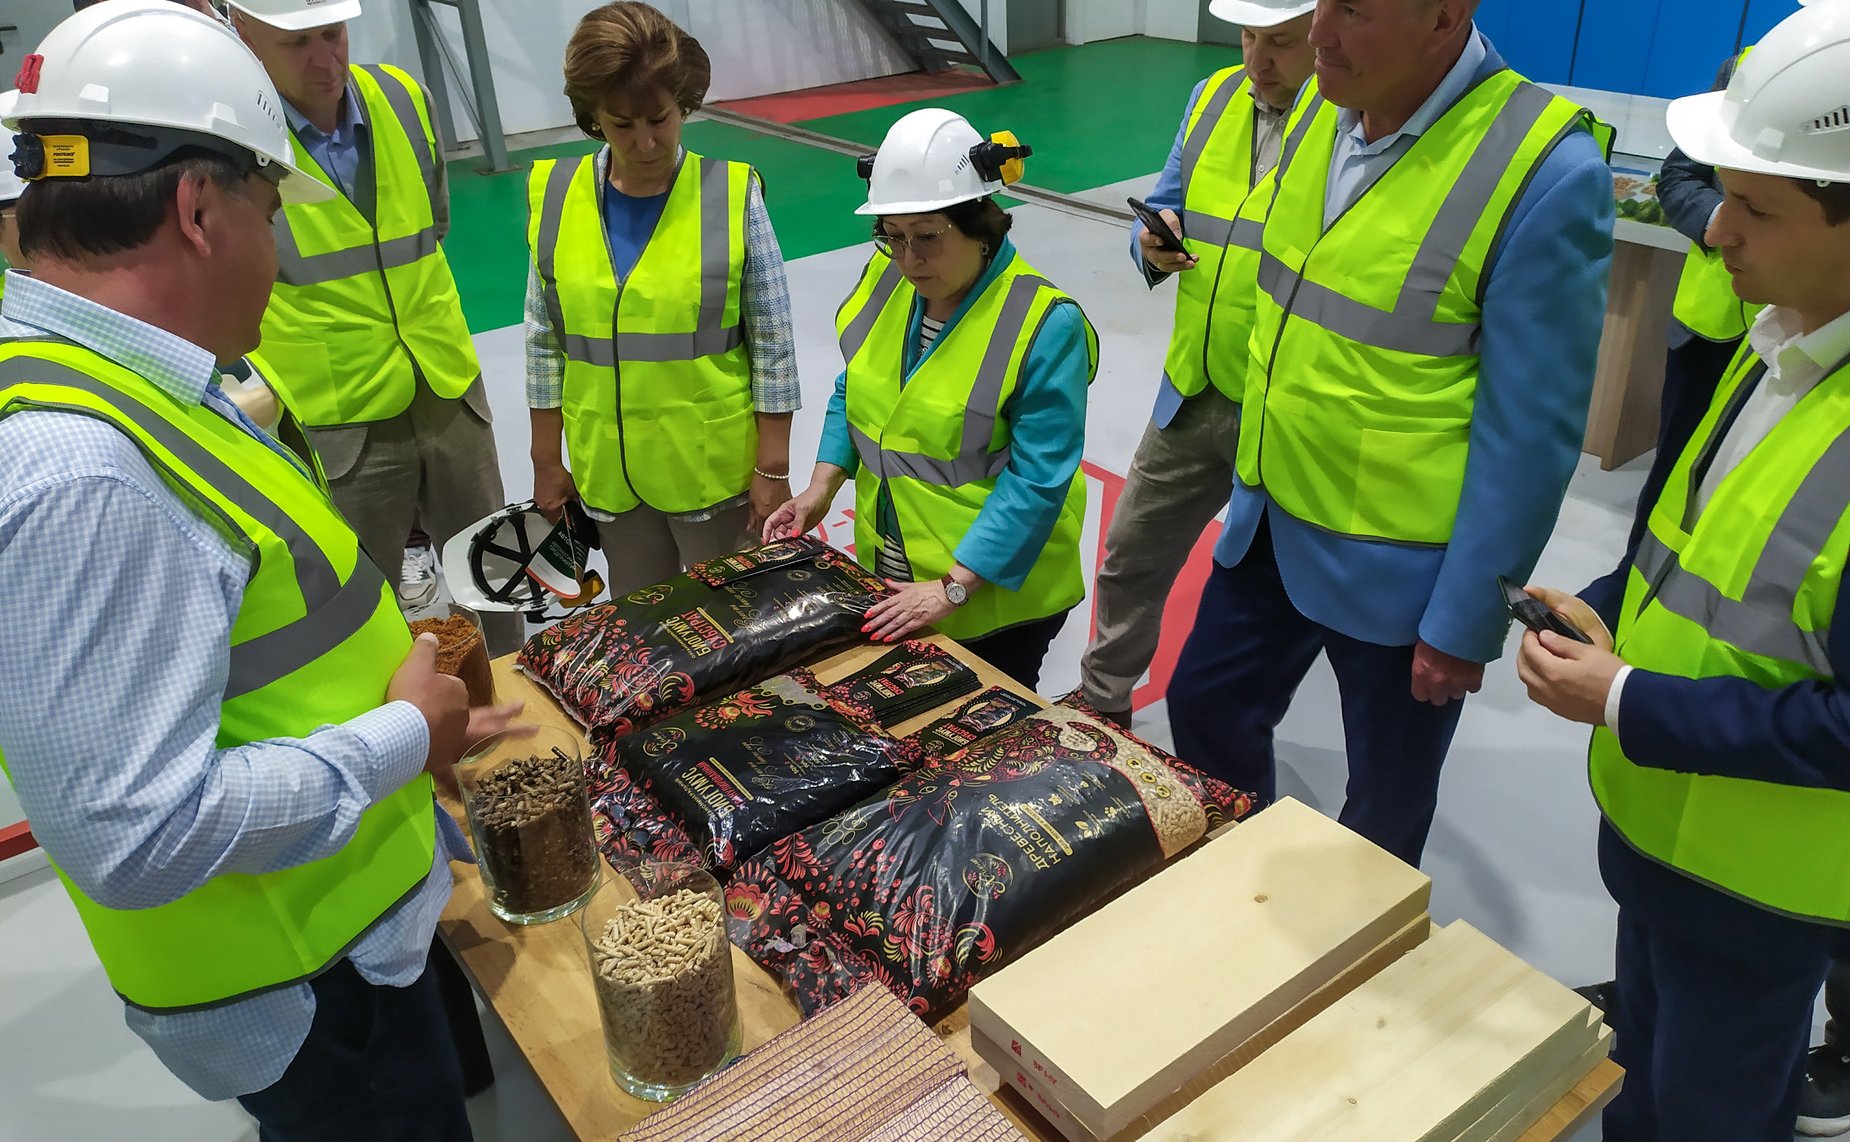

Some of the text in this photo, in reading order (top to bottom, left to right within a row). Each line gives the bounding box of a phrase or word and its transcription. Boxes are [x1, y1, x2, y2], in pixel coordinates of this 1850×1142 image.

[666, 616, 712, 657] БИОГУМУС
[681, 610, 727, 650] СУБСТРАТ
[935, 726, 970, 746] БИОГУМУС
[943, 722, 978, 741] СУБСТРАТ
[681, 767, 736, 818] БИОГУМУС
[981, 806, 1050, 870] ДРЕВЕСНЫЙ
[988, 793, 1062, 865] НАПОЛНИТЕЛЬ
